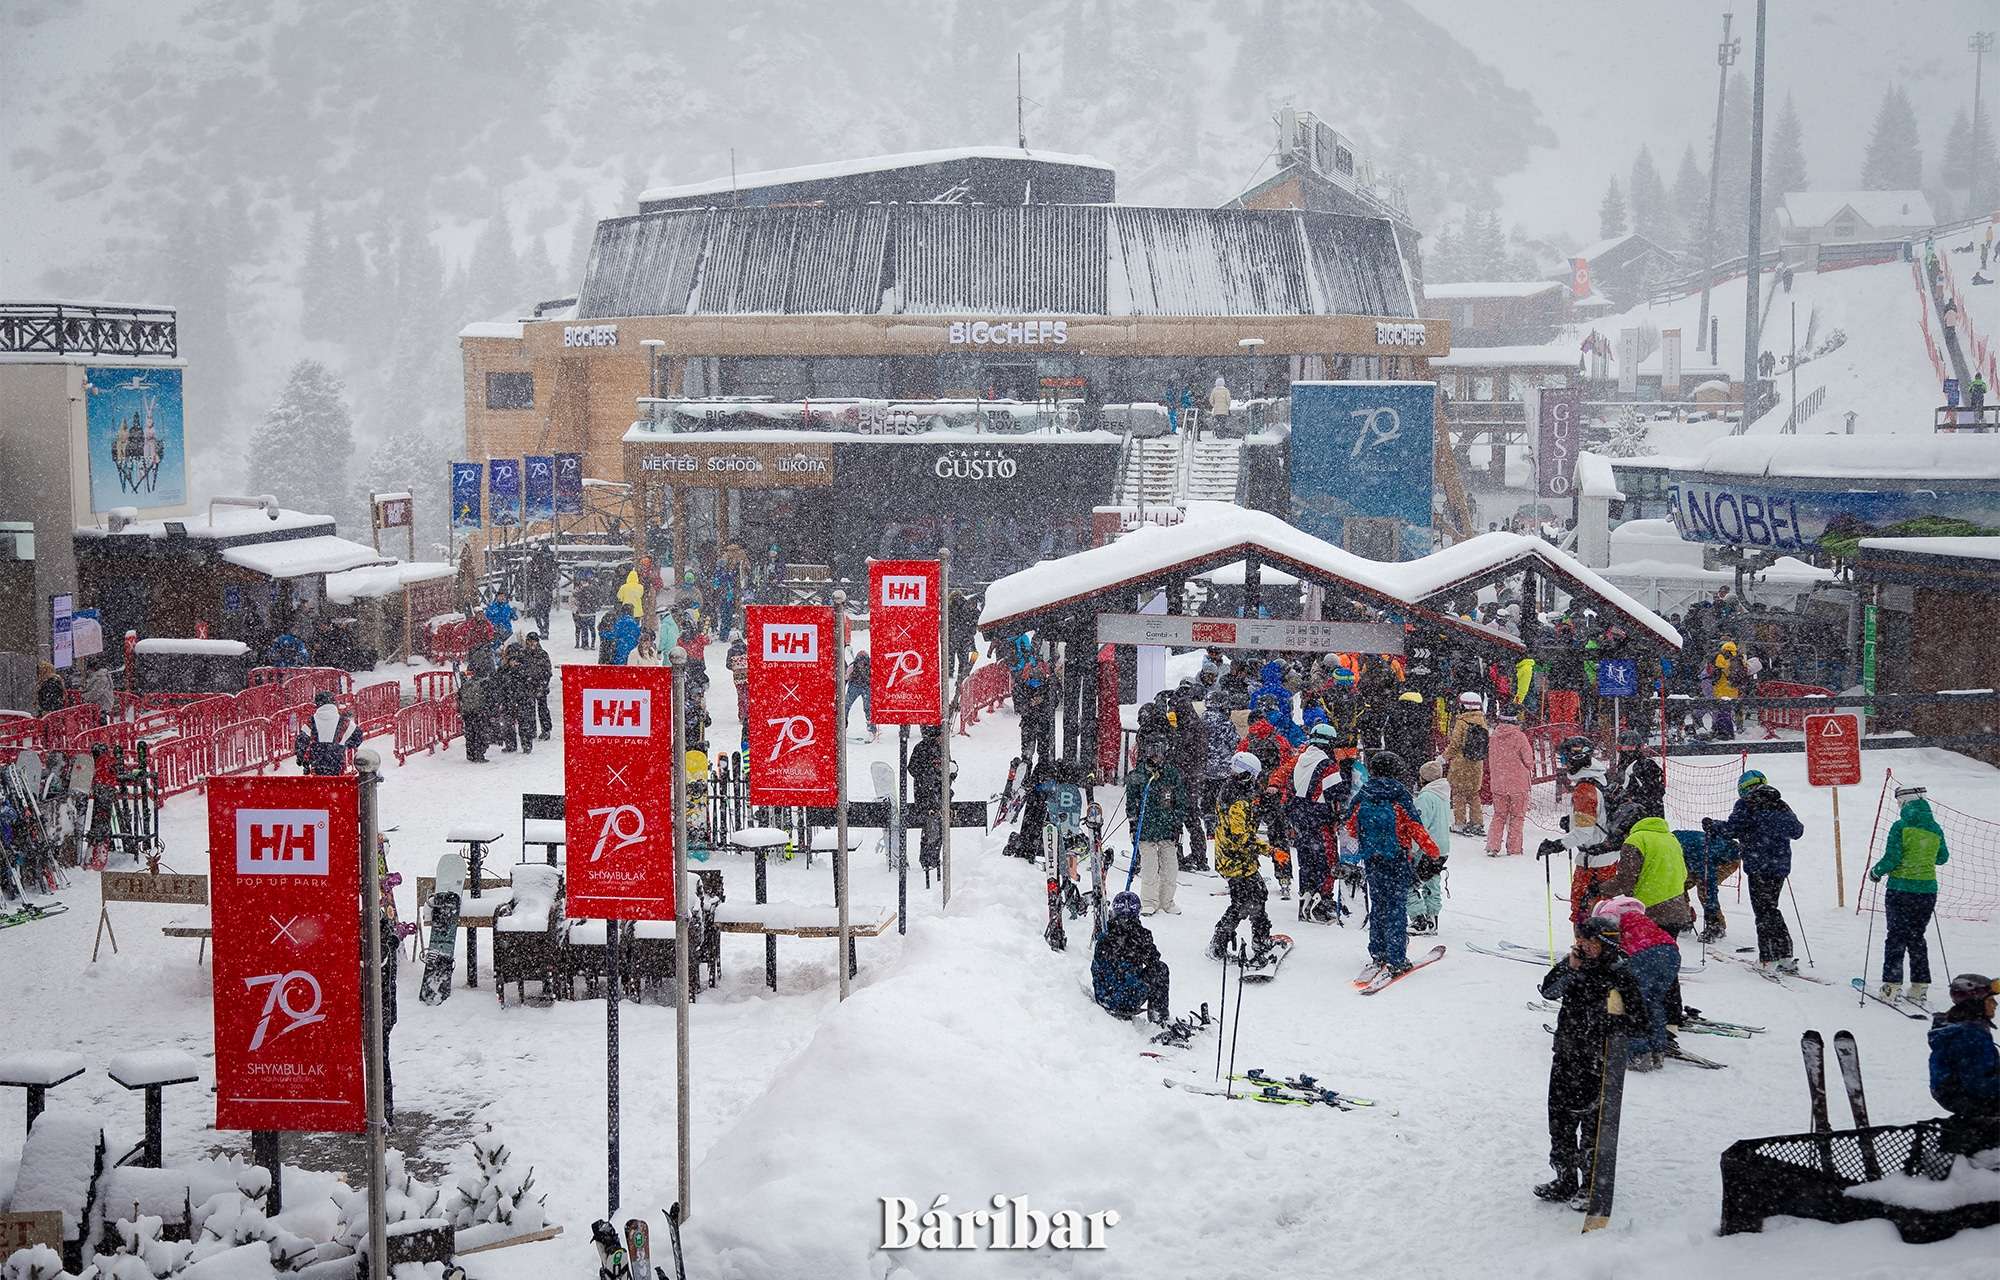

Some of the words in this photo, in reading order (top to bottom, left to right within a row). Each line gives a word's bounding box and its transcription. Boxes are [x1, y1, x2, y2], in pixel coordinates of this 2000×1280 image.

[564, 325, 618, 347] BIGCHEFS
[949, 321, 1068, 344] BIGCHEFS
[1376, 323, 1426, 346] BIGCHEFS
[988, 421, 1021, 430] LOVE
[1350, 407, 1402, 459] 70
[1550, 403, 1570, 494] GUSTO
[778, 460, 826, 472] ШКОЛА
[935, 457, 1017, 480] GUSTO
[884, 650, 924, 689] 70
[767, 715, 817, 762] 70
[587, 805, 648, 863] 70
[236, 878, 263, 887] POP
[269, 878, 288, 886] UP
[294, 878, 328, 887] PARK
[588, 870, 646, 881] SHYMBULAK
[244, 970, 327, 1051] 70
[247, 1062, 325, 1076] SHYMBULAK
